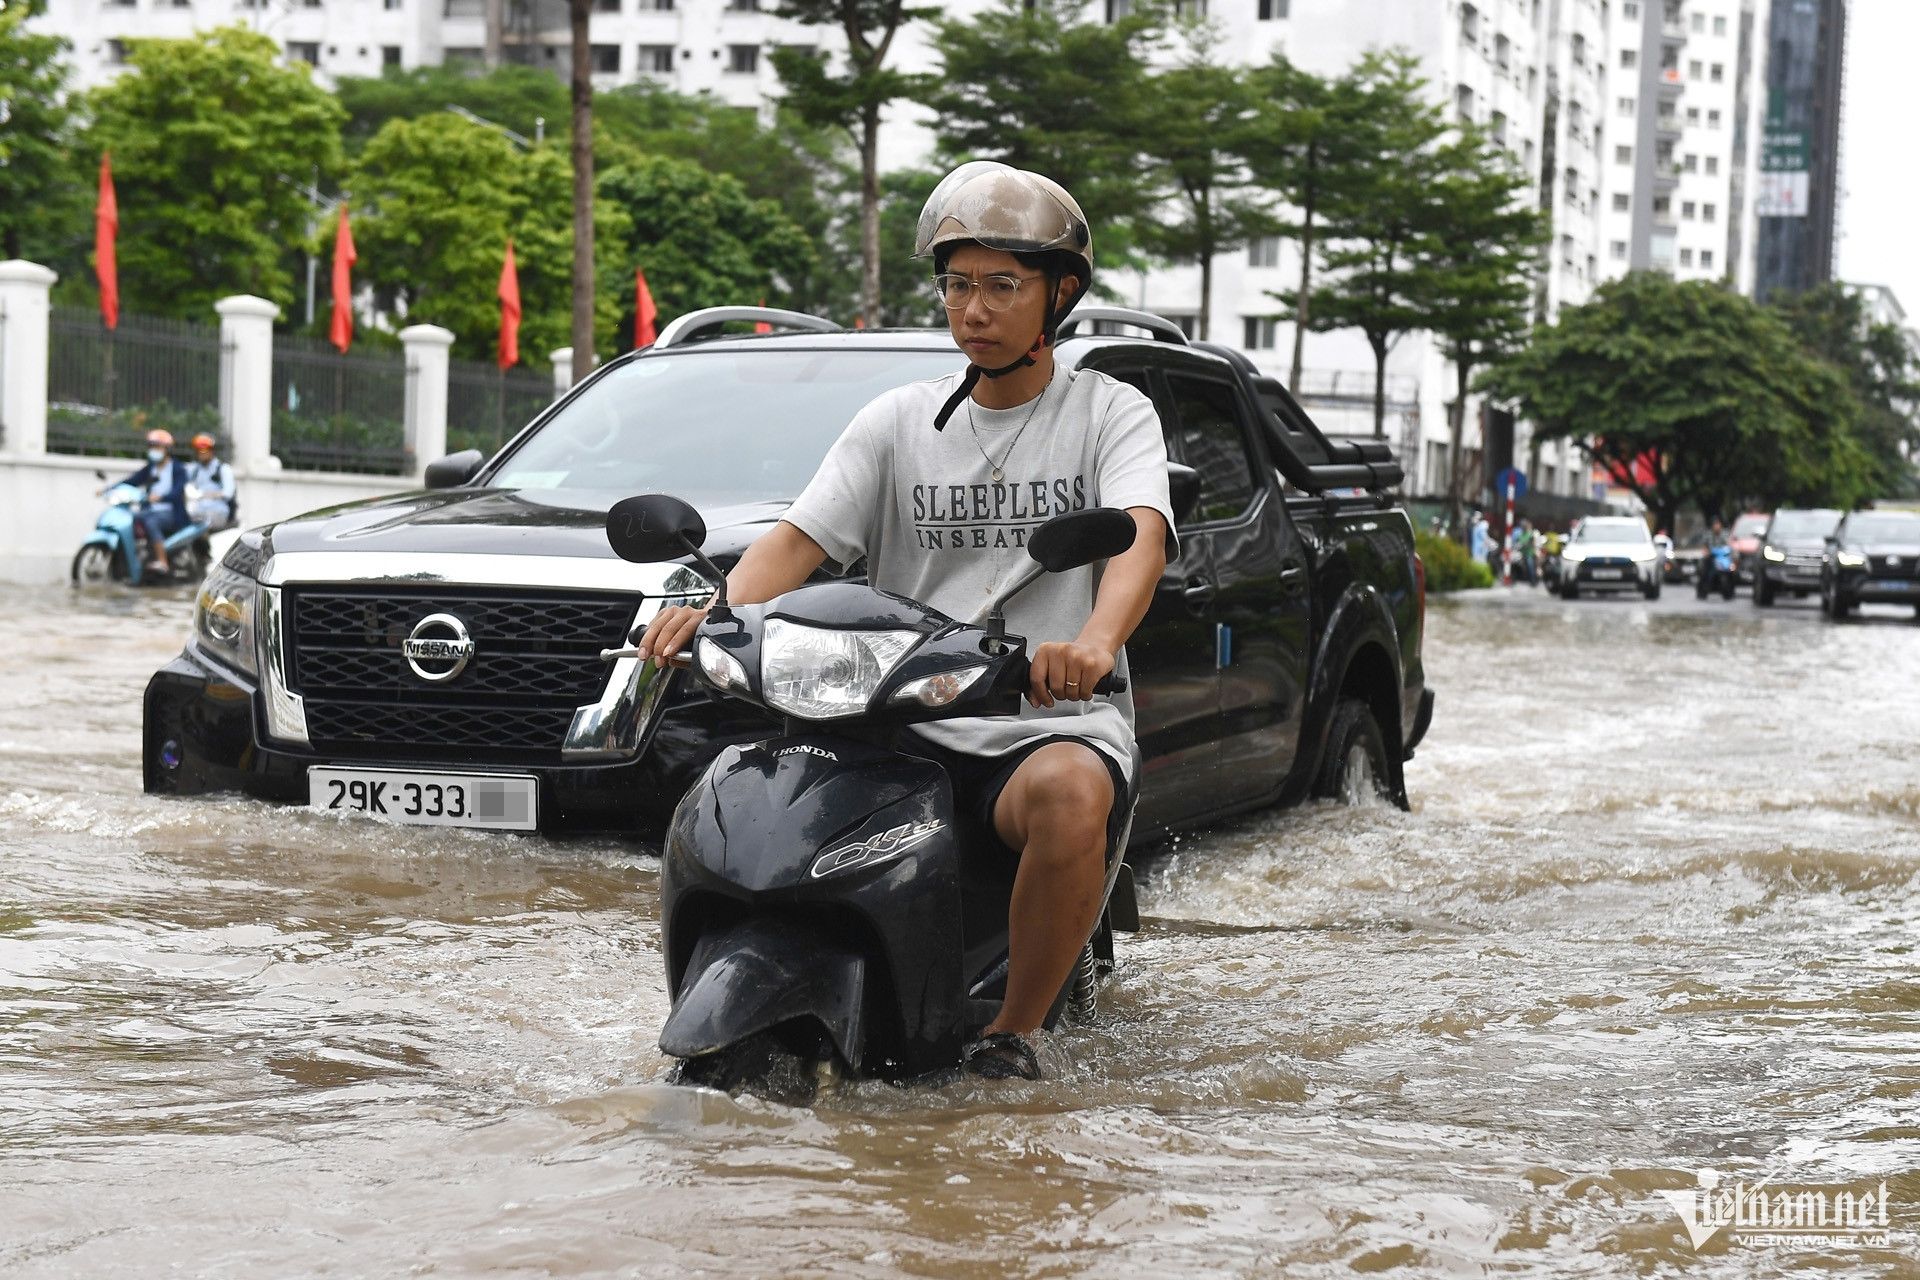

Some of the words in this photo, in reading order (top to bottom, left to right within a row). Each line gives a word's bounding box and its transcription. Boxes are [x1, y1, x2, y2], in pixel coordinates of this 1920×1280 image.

[912, 474, 1086, 522] SLEEPLESS
[405, 642, 464, 656] NISSAN
[778, 744, 839, 762] HONDA
[328, 779, 529, 822] 29K-333.
